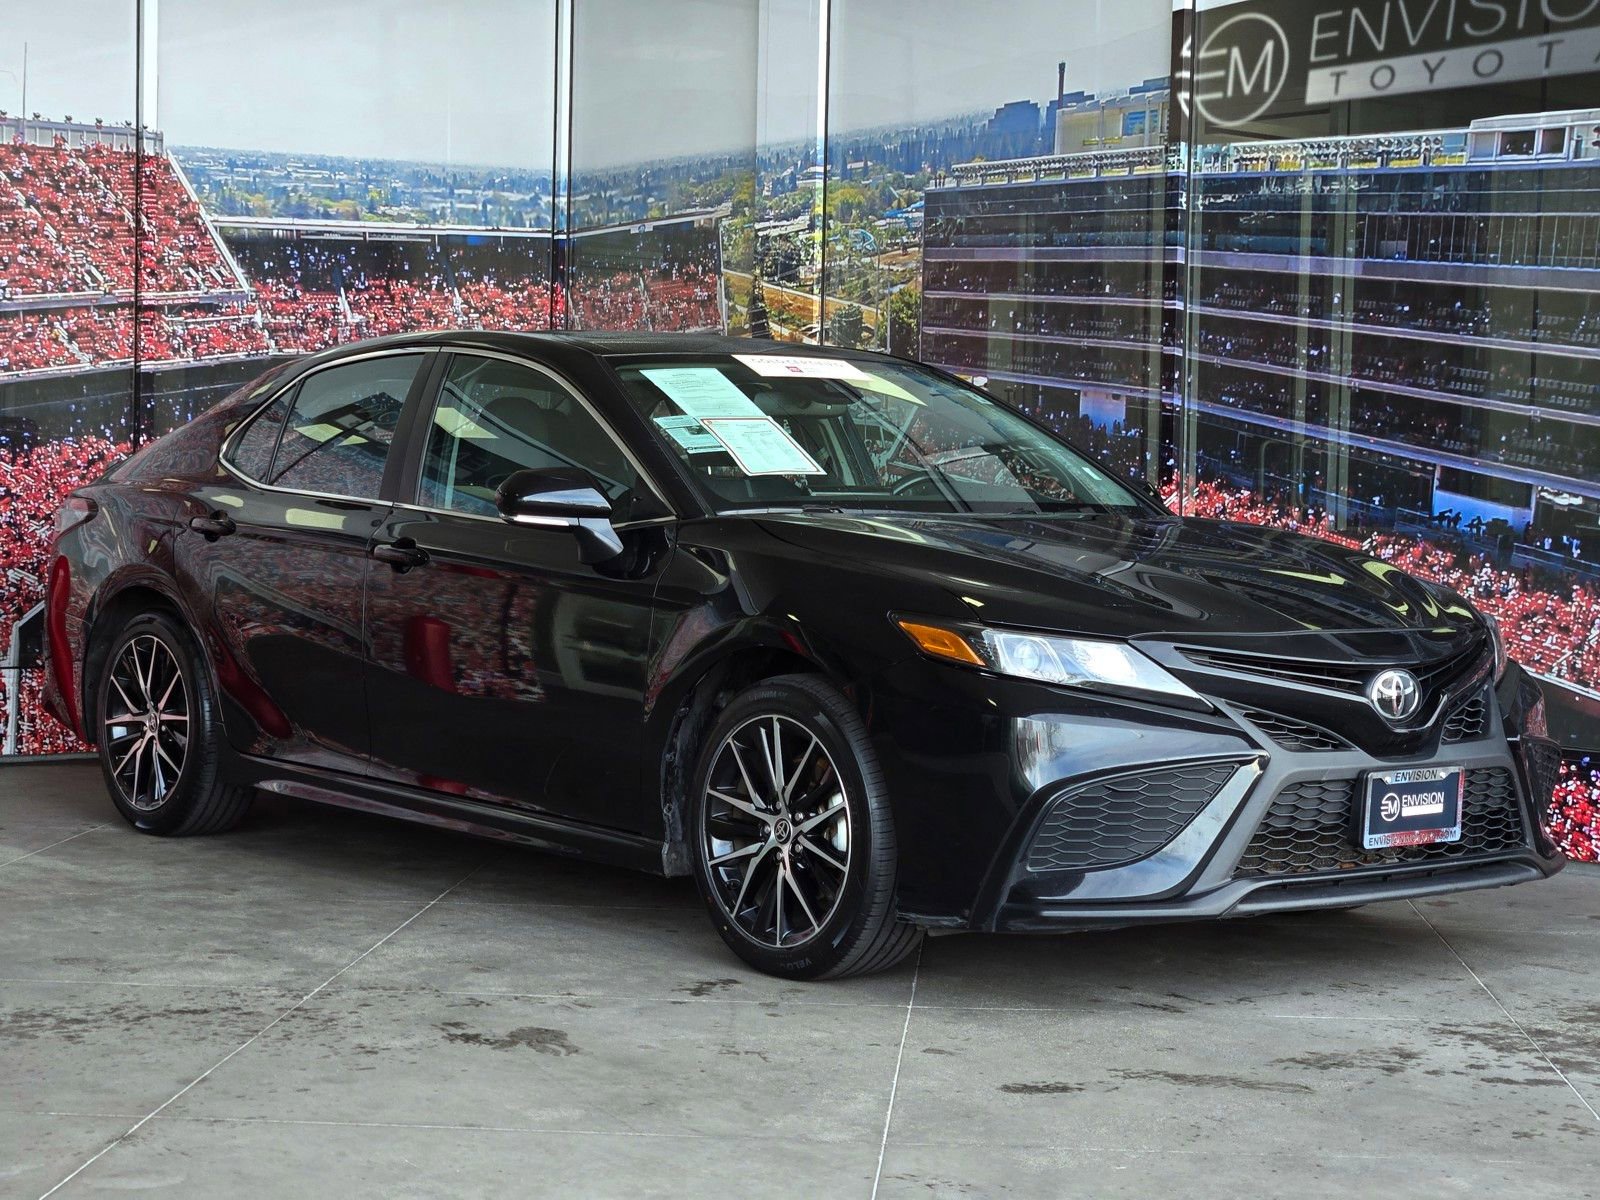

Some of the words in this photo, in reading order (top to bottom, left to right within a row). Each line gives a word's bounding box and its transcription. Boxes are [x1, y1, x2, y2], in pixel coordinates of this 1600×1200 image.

[1330, 39, 1600, 96] TOYOT
[1394, 769, 1438, 783] ENVISION
[1402, 792, 1445, 807] ENVISION
